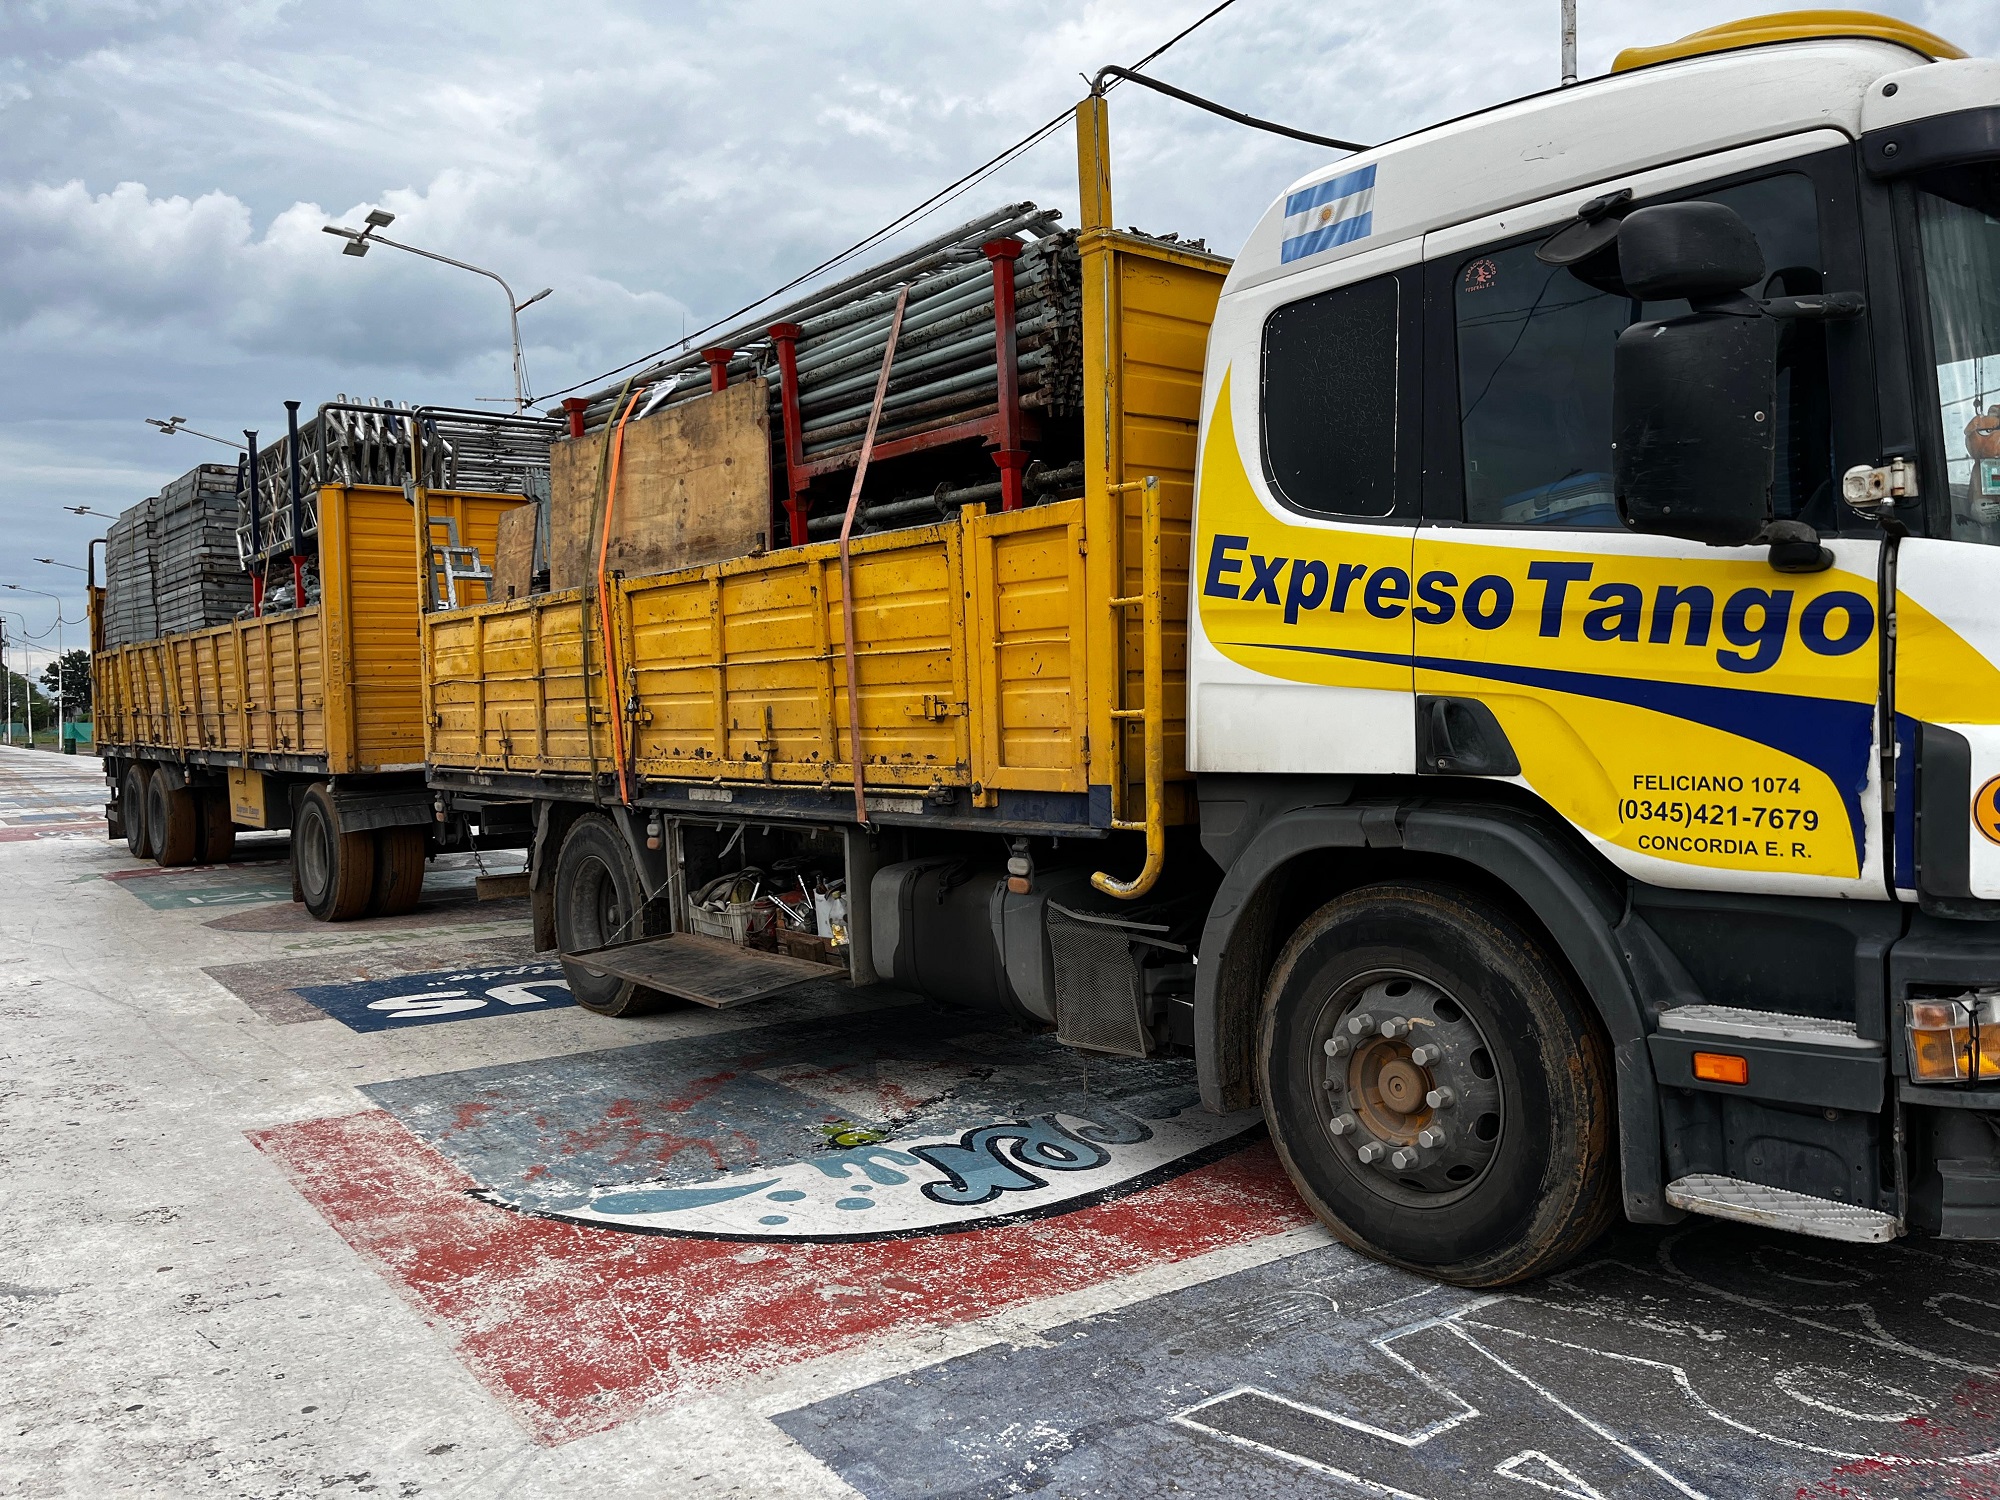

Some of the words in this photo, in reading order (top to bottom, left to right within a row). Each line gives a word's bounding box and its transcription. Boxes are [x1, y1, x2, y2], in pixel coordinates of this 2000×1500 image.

[1204, 534, 1514, 630] Expreso
[1527, 561, 1874, 673] Tango
[1633, 775, 1743, 792] FELICIANO
[1751, 777, 1800, 794] 1074
[1618, 799, 1819, 831] (0345)421-7679
[1638, 835, 1758, 855] CONCORDIA
[1765, 841, 1784, 857] E.
[1792, 843, 1812, 858] R.
